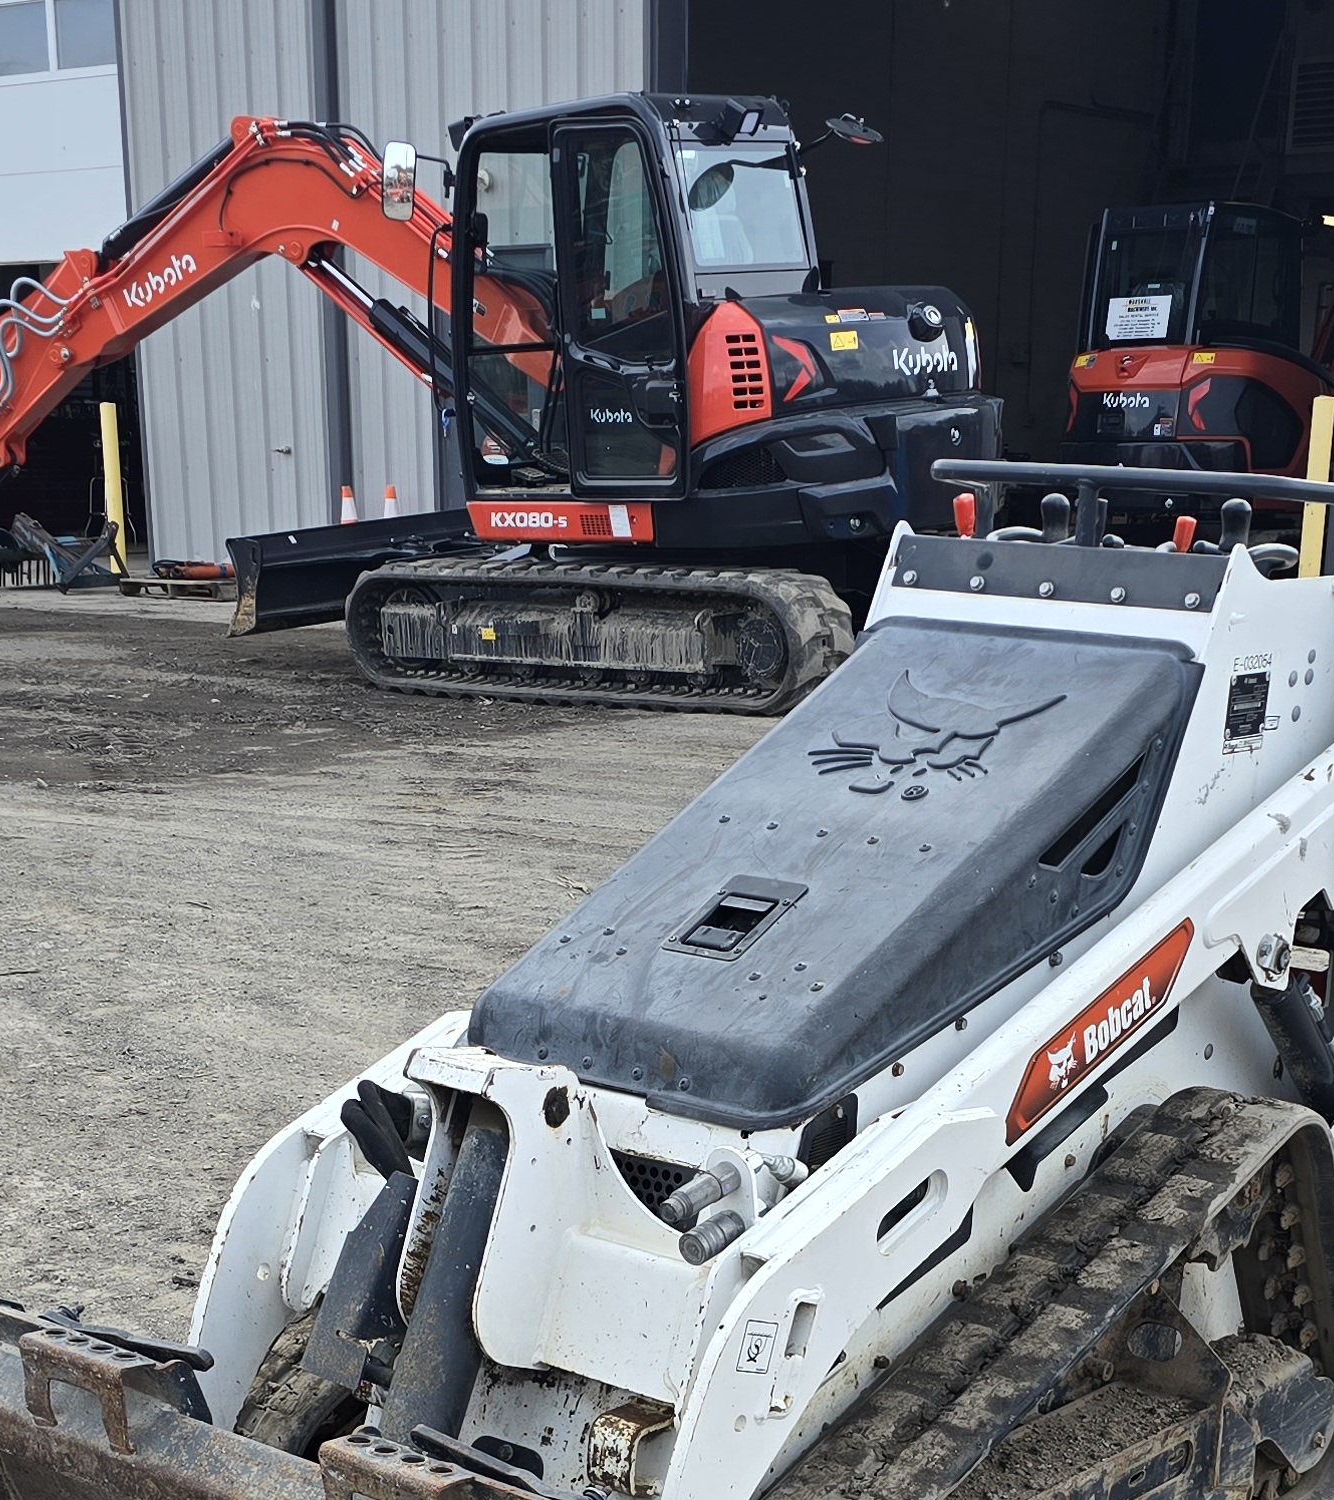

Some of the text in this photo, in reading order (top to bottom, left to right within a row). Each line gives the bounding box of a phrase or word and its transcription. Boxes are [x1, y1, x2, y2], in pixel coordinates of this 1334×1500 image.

[123, 254, 197, 307] Kubota
[892, 344, 958, 376] Kubota
[1103, 392, 1150, 408] Kubota
[590, 408, 633, 423] Kubota
